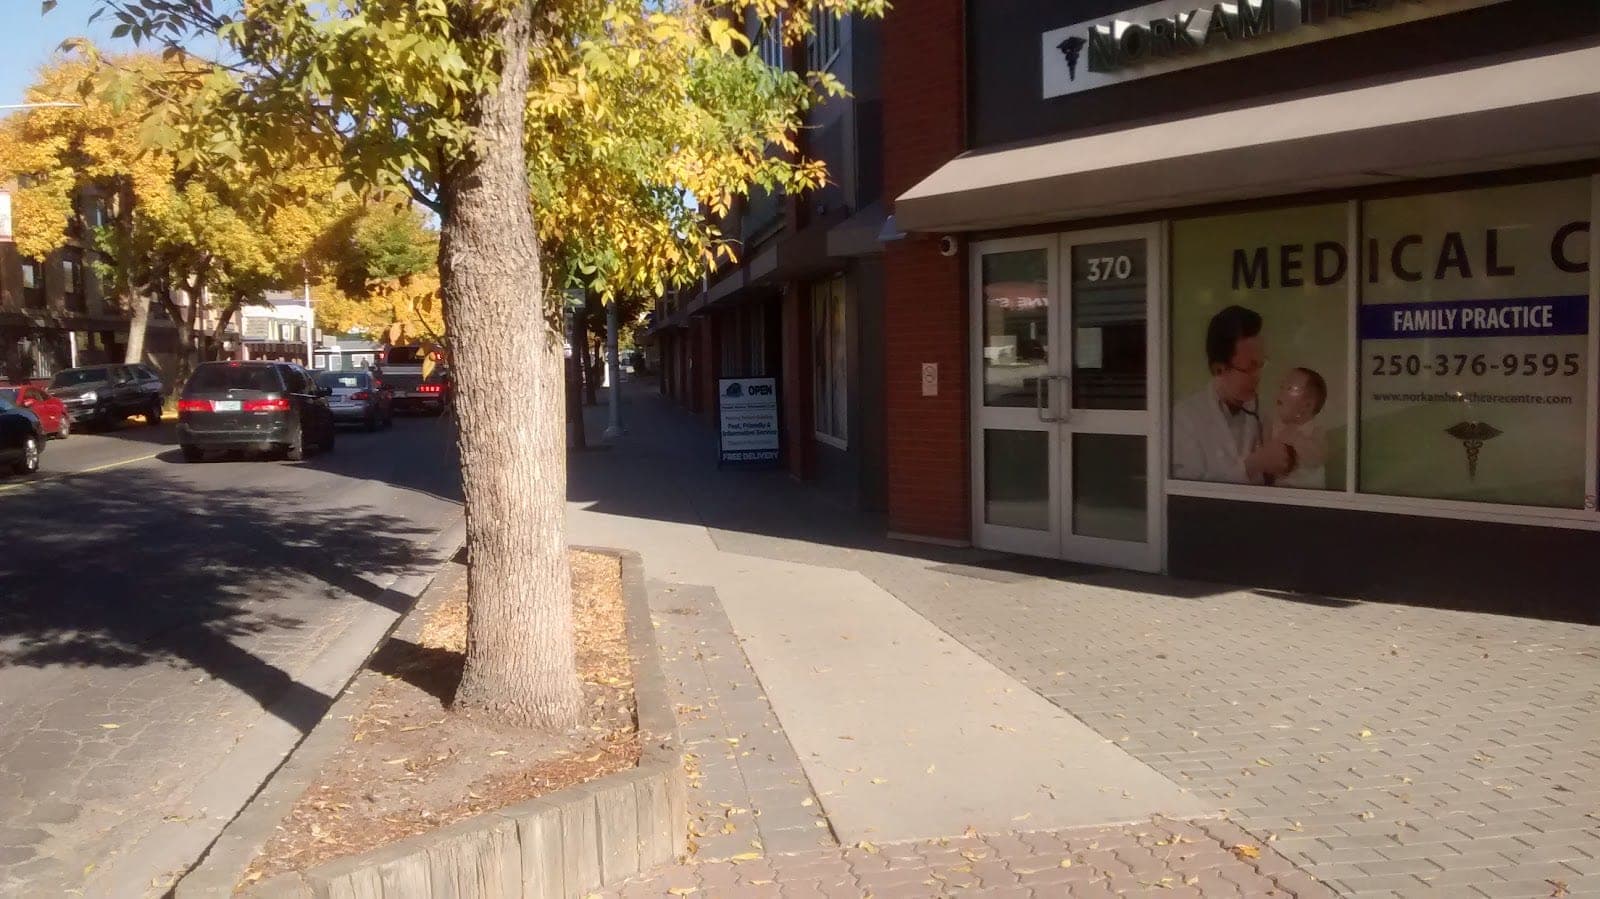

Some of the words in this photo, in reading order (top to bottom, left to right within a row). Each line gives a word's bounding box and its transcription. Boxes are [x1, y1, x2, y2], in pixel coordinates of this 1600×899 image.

[1087, 0, 1277, 73] NORKAM
[1086, 255, 1132, 282] 370
[1232, 229, 1515, 290] MEDICAL
[1393, 309, 1455, 331] FAMILY
[1461, 305, 1553, 329] PRACTICE
[1372, 353, 1580, 376] 250-376-9595
[748, 385, 772, 396] OPEN
